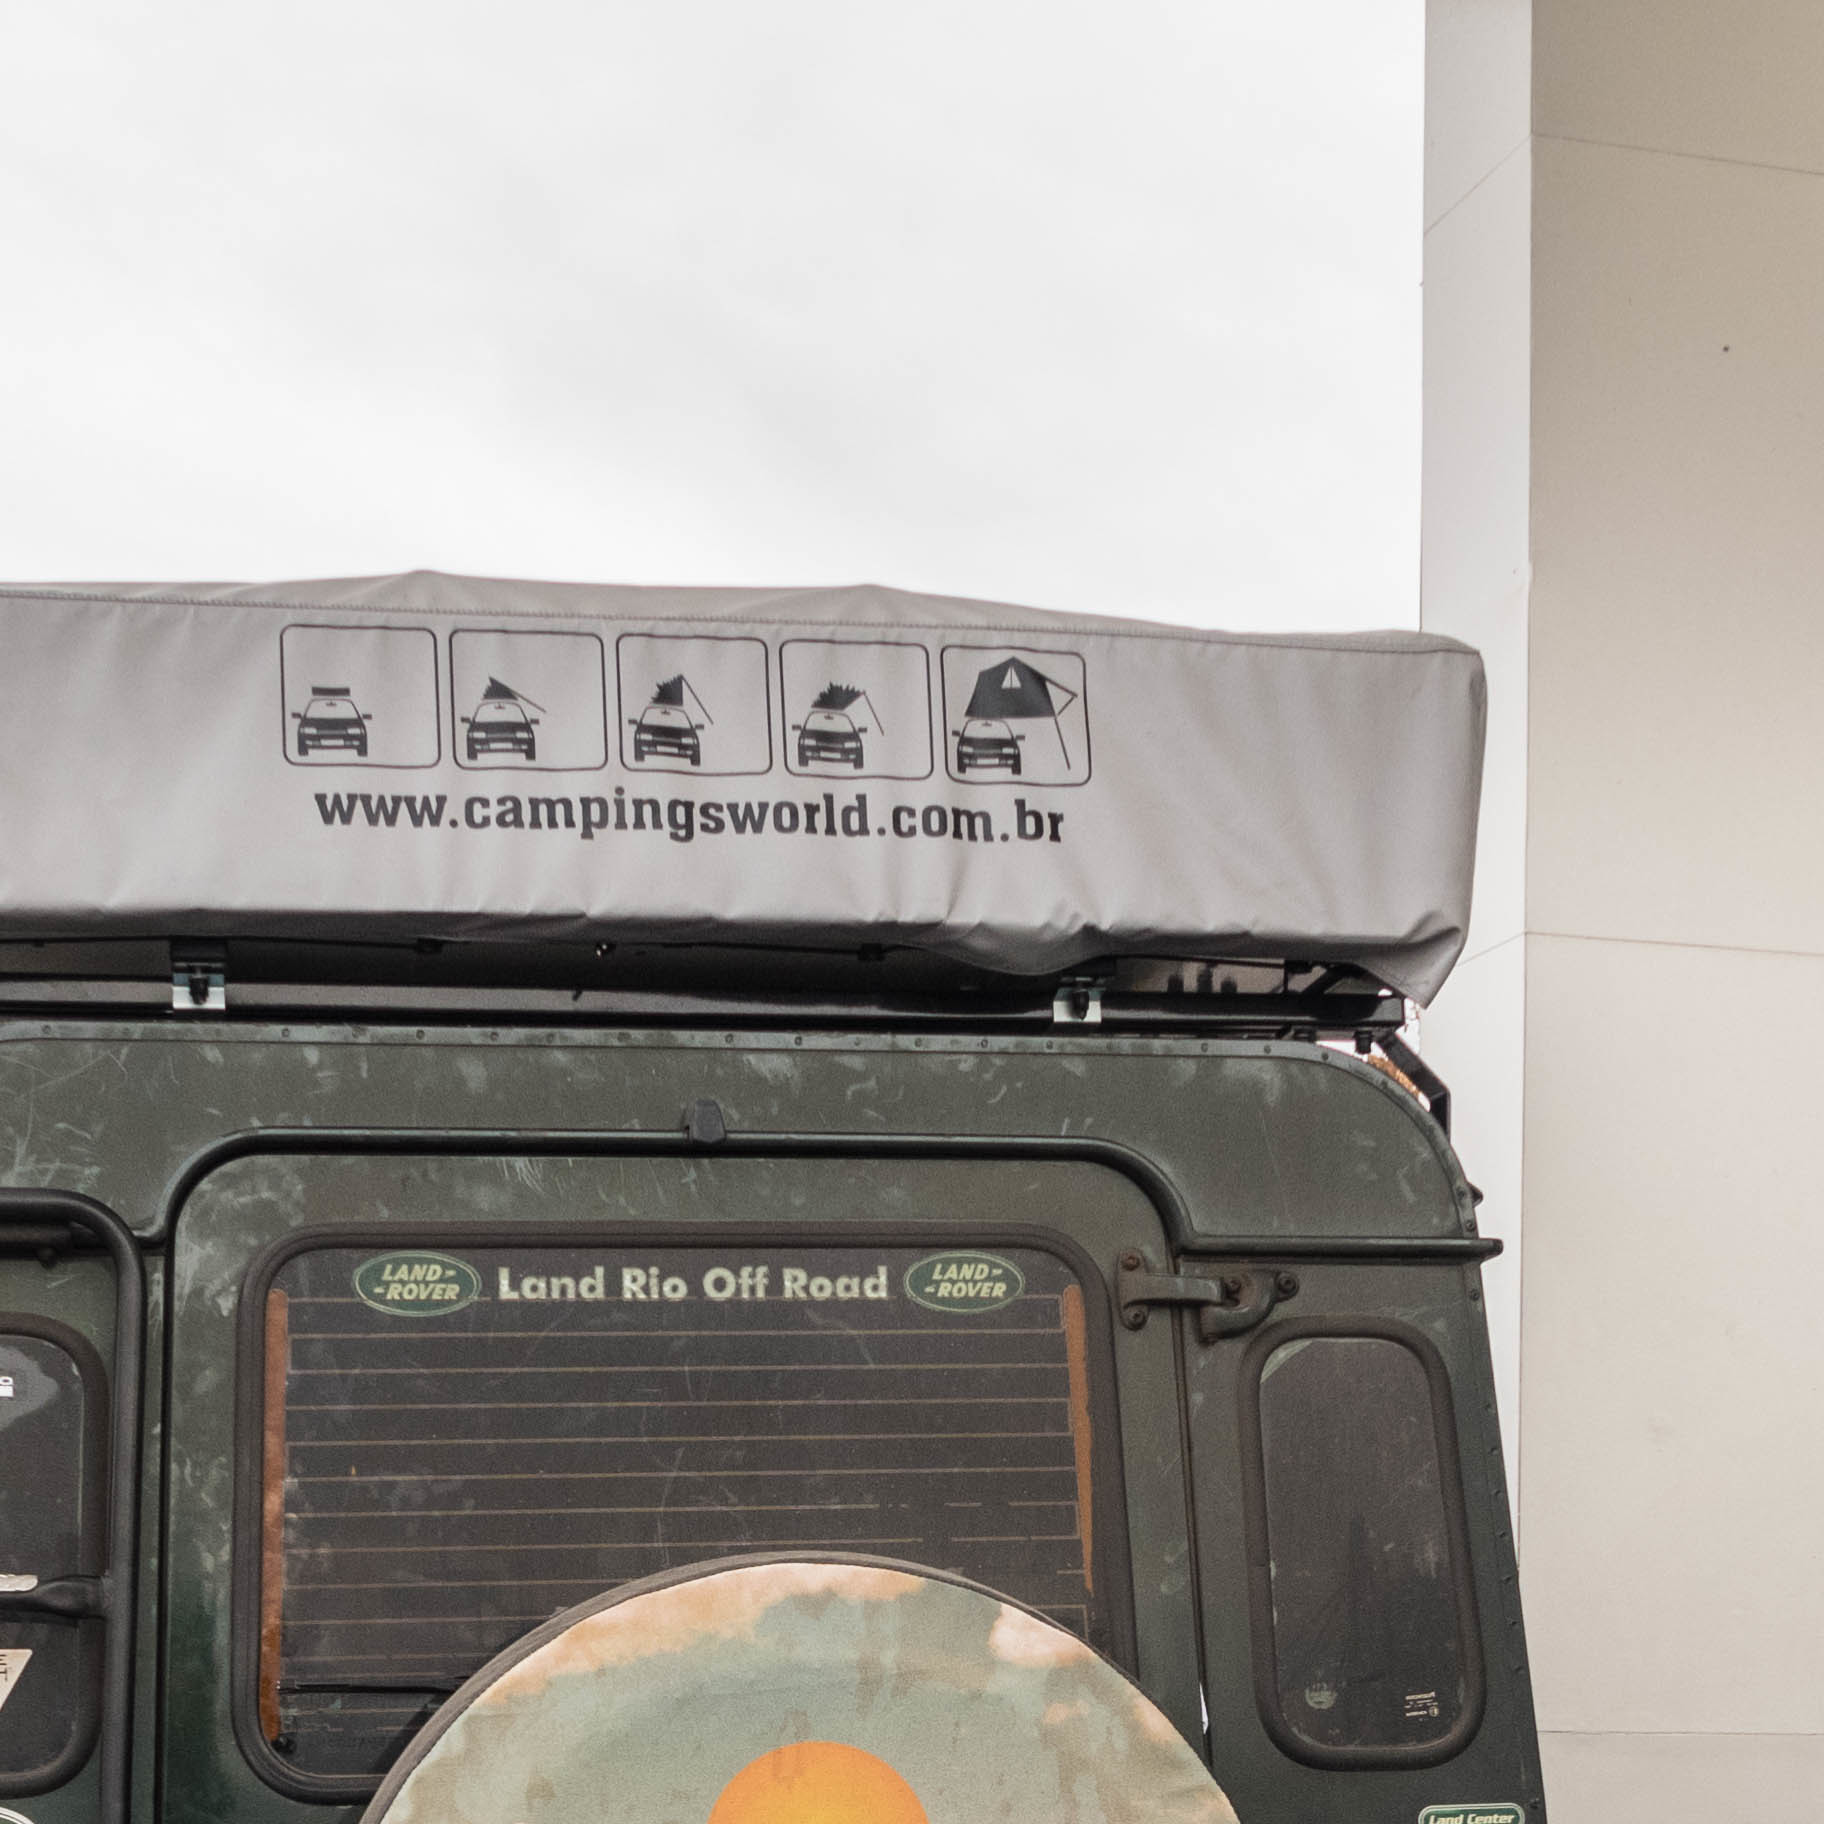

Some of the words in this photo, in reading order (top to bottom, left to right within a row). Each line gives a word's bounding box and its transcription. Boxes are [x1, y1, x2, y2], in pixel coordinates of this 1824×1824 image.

[314, 786, 1065, 843] www.campingsworld.com.br
[381, 1263, 444, 1282] LAND
[930, 1262, 983, 1281] LAND
[381, 1281, 460, 1302] ROVER
[497, 1265, 607, 1300] Land
[622, 1264, 688, 1300] Rio
[702, 1266, 769, 1301] Off
[784, 1266, 888, 1301] Road
[933, 1280, 1008, 1300] ROVER
[1467, 1813, 1515, 1824] Center
